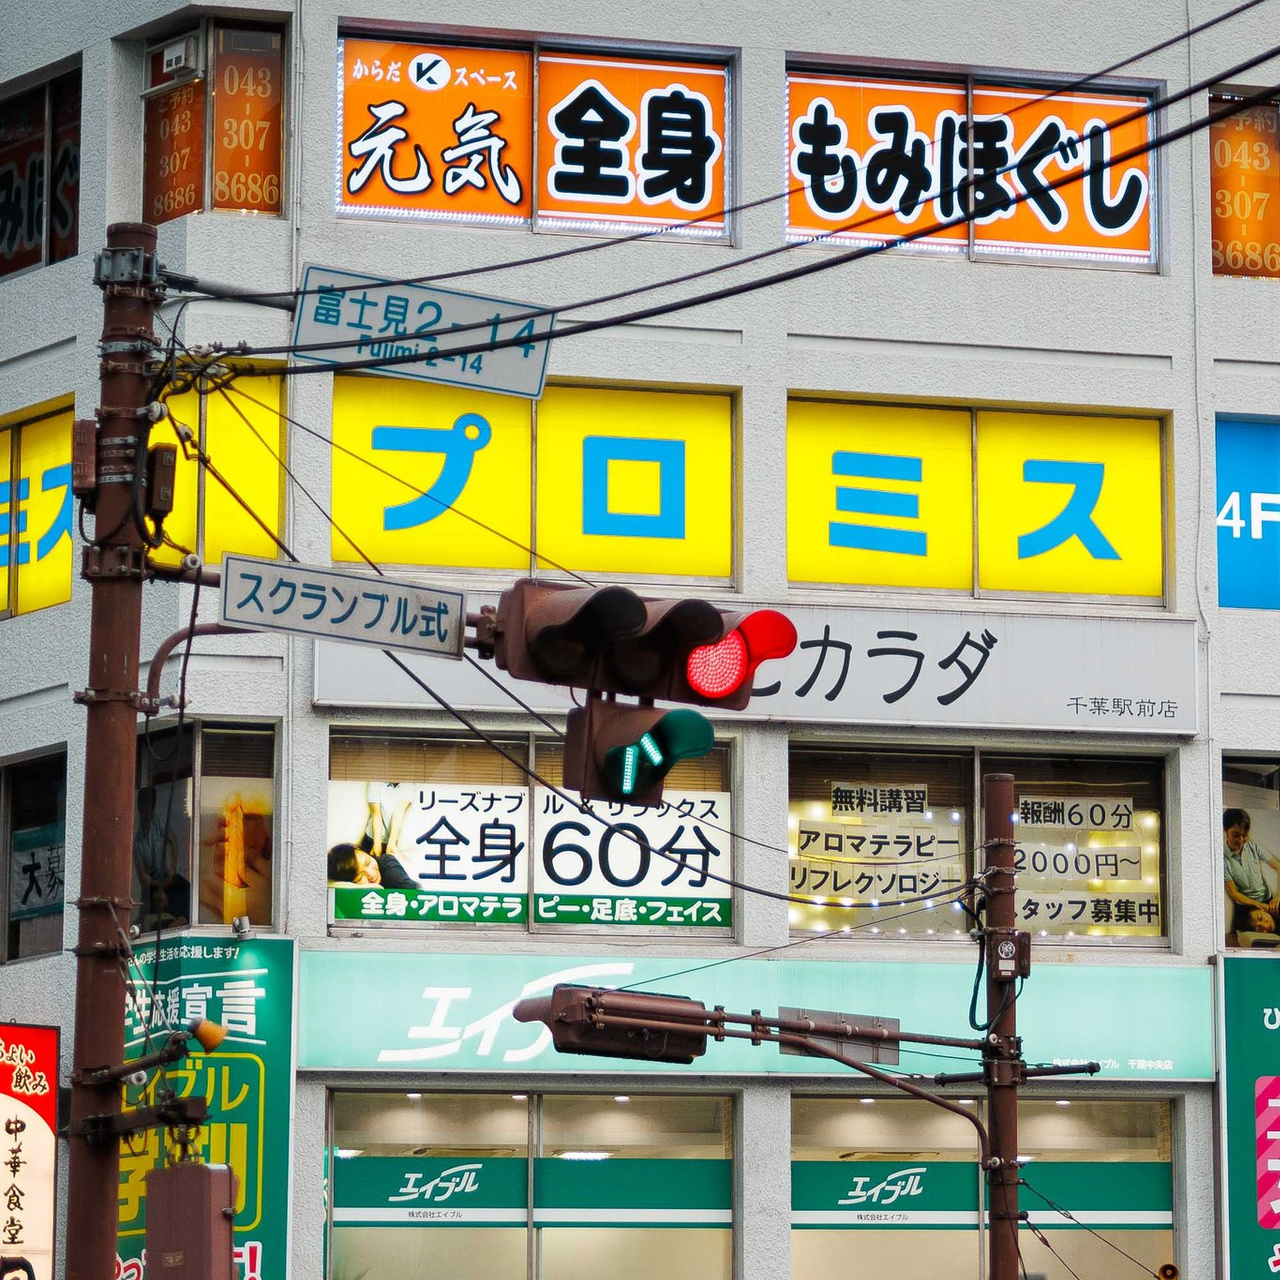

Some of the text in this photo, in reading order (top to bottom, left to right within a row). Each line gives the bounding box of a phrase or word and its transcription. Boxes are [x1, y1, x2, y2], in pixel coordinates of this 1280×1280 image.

[223, 65, 272, 98] 043
[351, 57, 403, 84] からだ
[453, 64, 518, 91] スペース
[222, 118, 271, 151] 307
[547, 77, 721, 211] 全身
[348, 100, 522, 205] 元気
[791, 97, 1149, 238] もみほぐし
[1213, 139, 1271, 171] 043
[214, 171, 280, 205] 8686
[1215, 189, 1271, 221] 307
[372, 413, 1122, 561] プロミス
[236, 571, 449, 643] スクランブル式
[750, 625, 998, 705] カラダ
[1066, 696, 1179, 720] 千葉駅前店
[418, 789, 563, 816] リーズナブル
[832, 787, 927, 814] 無料講習
[1020, 800, 1133, 830] 報酬60分
[799, 829, 960, 858] アロマテラピー
[790, 865, 961, 895] リフレクソロジー
[1014, 898, 1160, 924] タッフ募集中
[379, 962, 634, 1061] エイ
[12, 1066, 50, 1094] 飲み
[3, 1114, 27, 1245] 中華食堂
[388, 1163, 483, 1202] エイブル
[837, 1167, 927, 1206] エイブル
[407, 1210, 463, 1219] 株式会社エイブル
[856, 1213, 909, 1222] 株式会社エイブル
